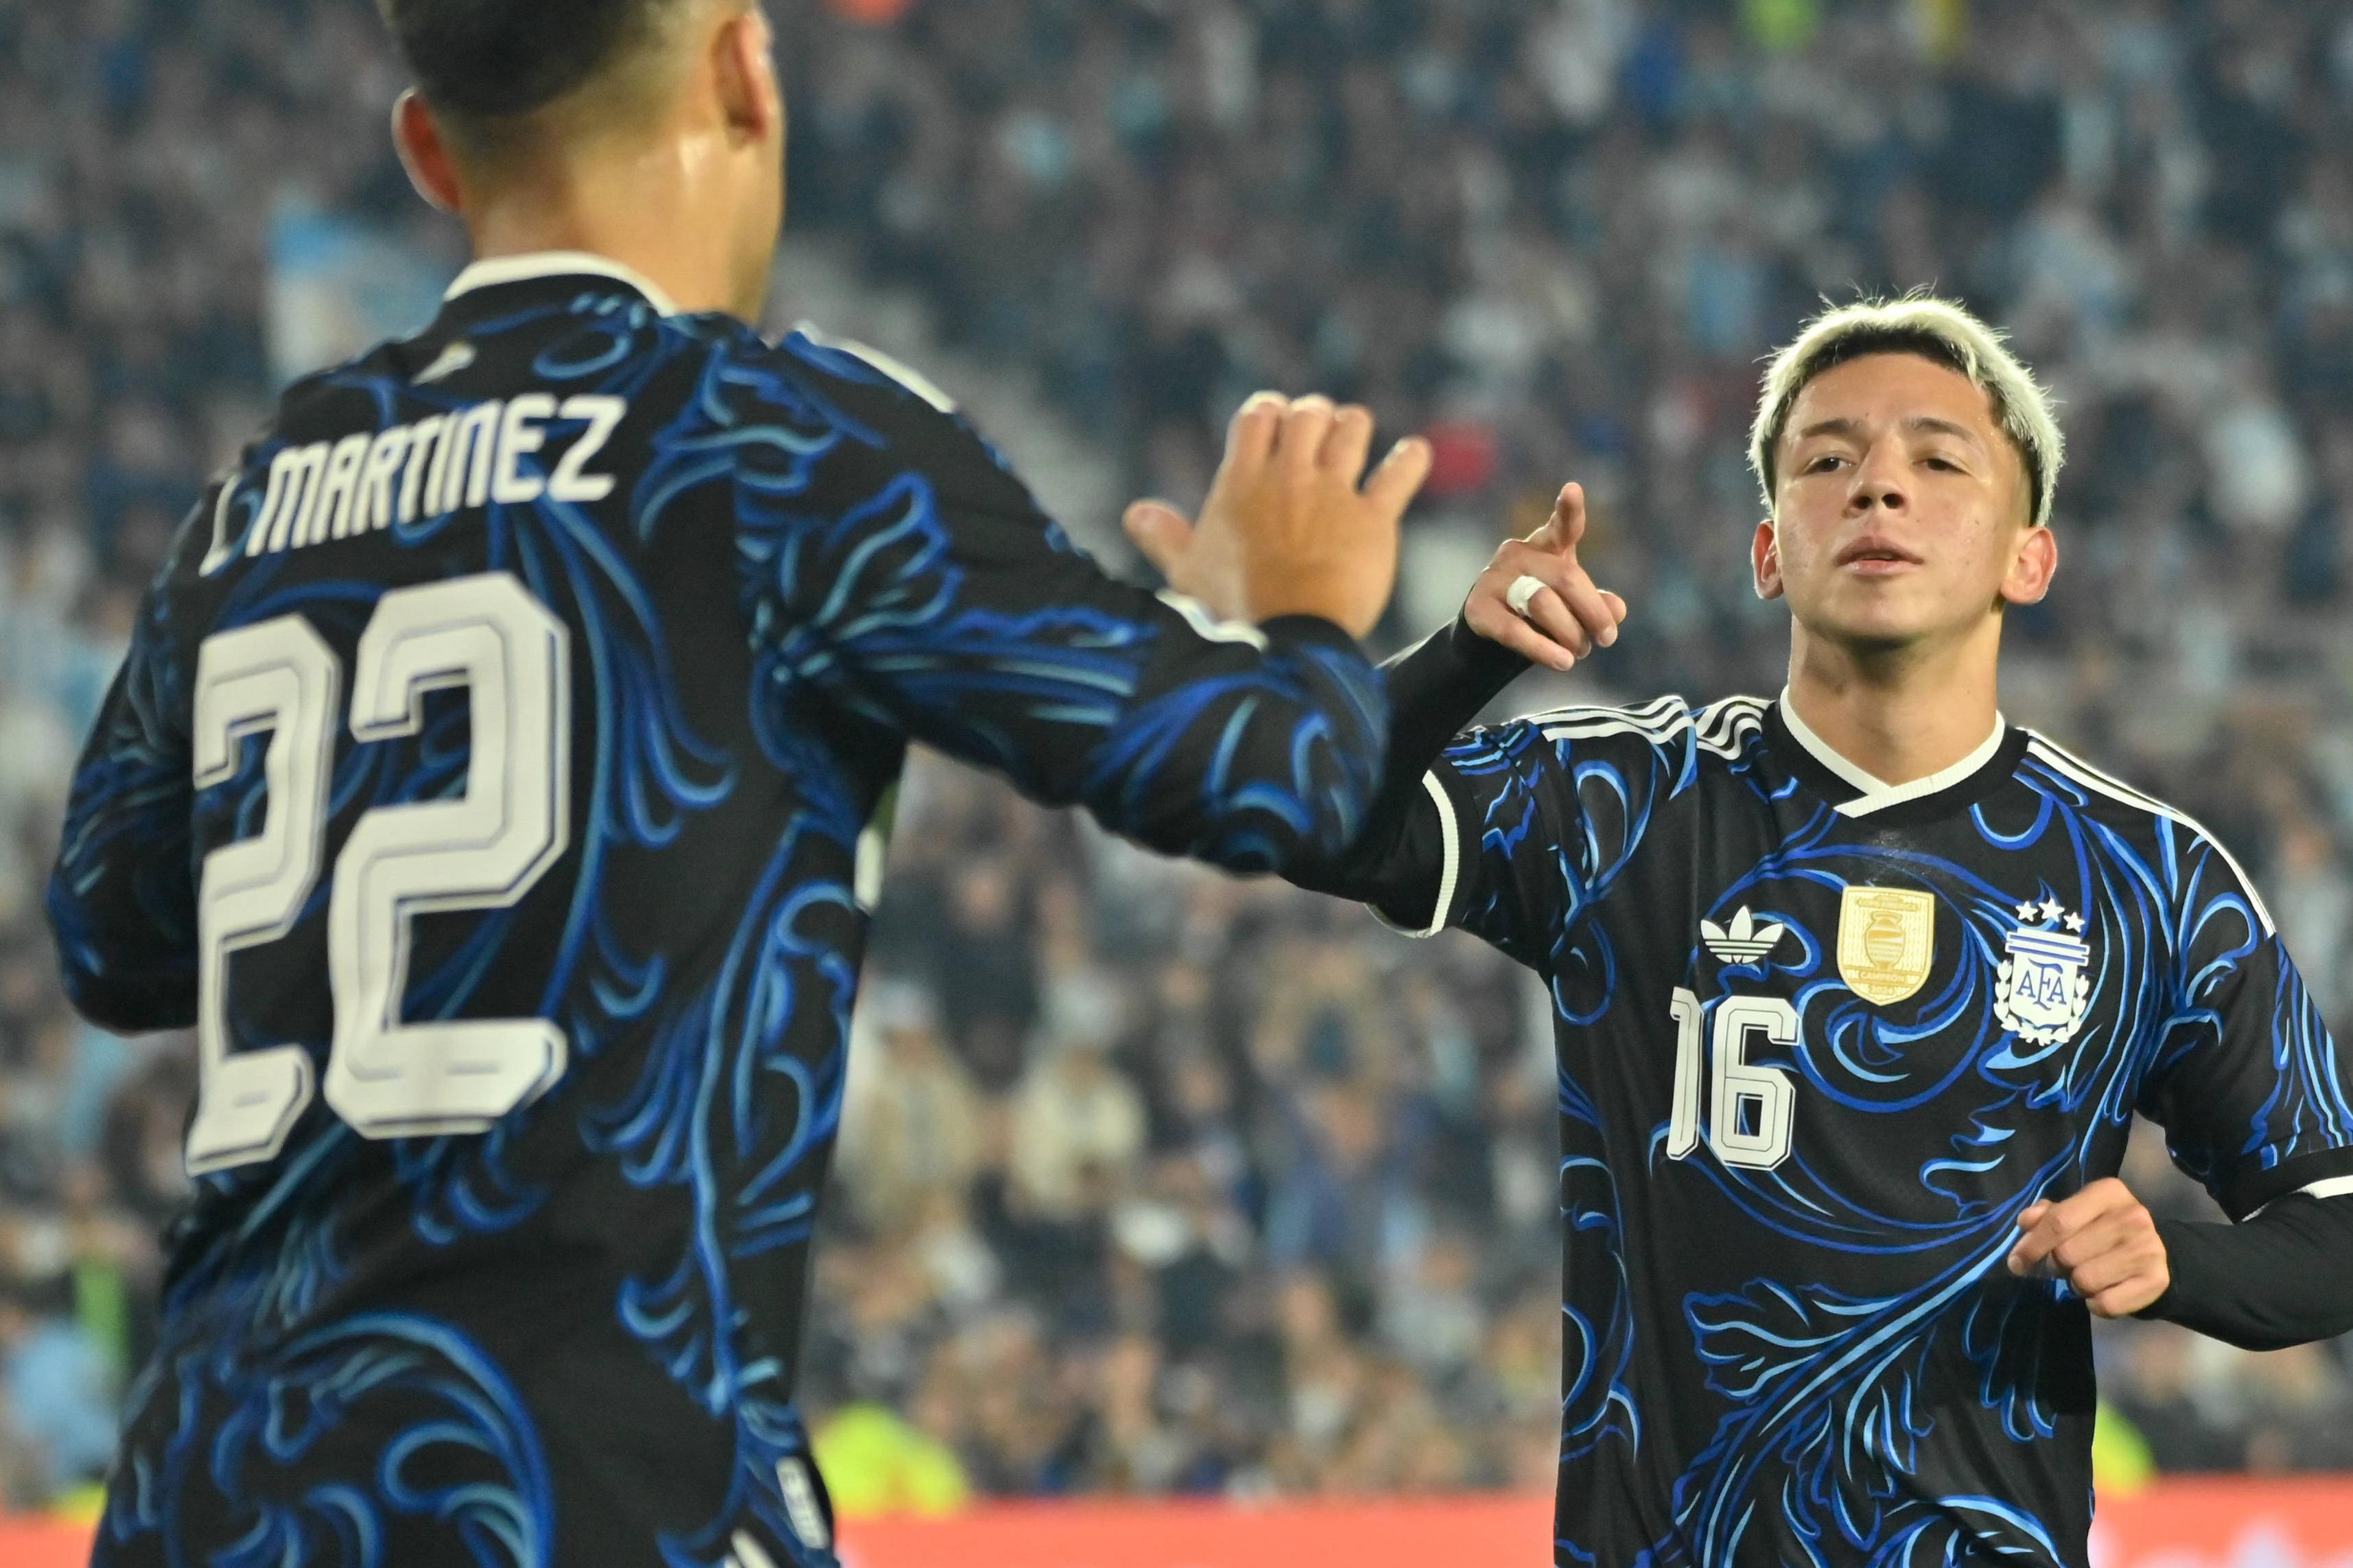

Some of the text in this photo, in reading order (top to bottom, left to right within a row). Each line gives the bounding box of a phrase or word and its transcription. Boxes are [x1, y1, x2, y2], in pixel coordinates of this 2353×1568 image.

[245, 393, 627, 557] MARTINEZ
[184, 570, 572, 1178] 22
[2015, 957, 2068, 1011] AFA
[1665, 985, 1803, 1172] 16
